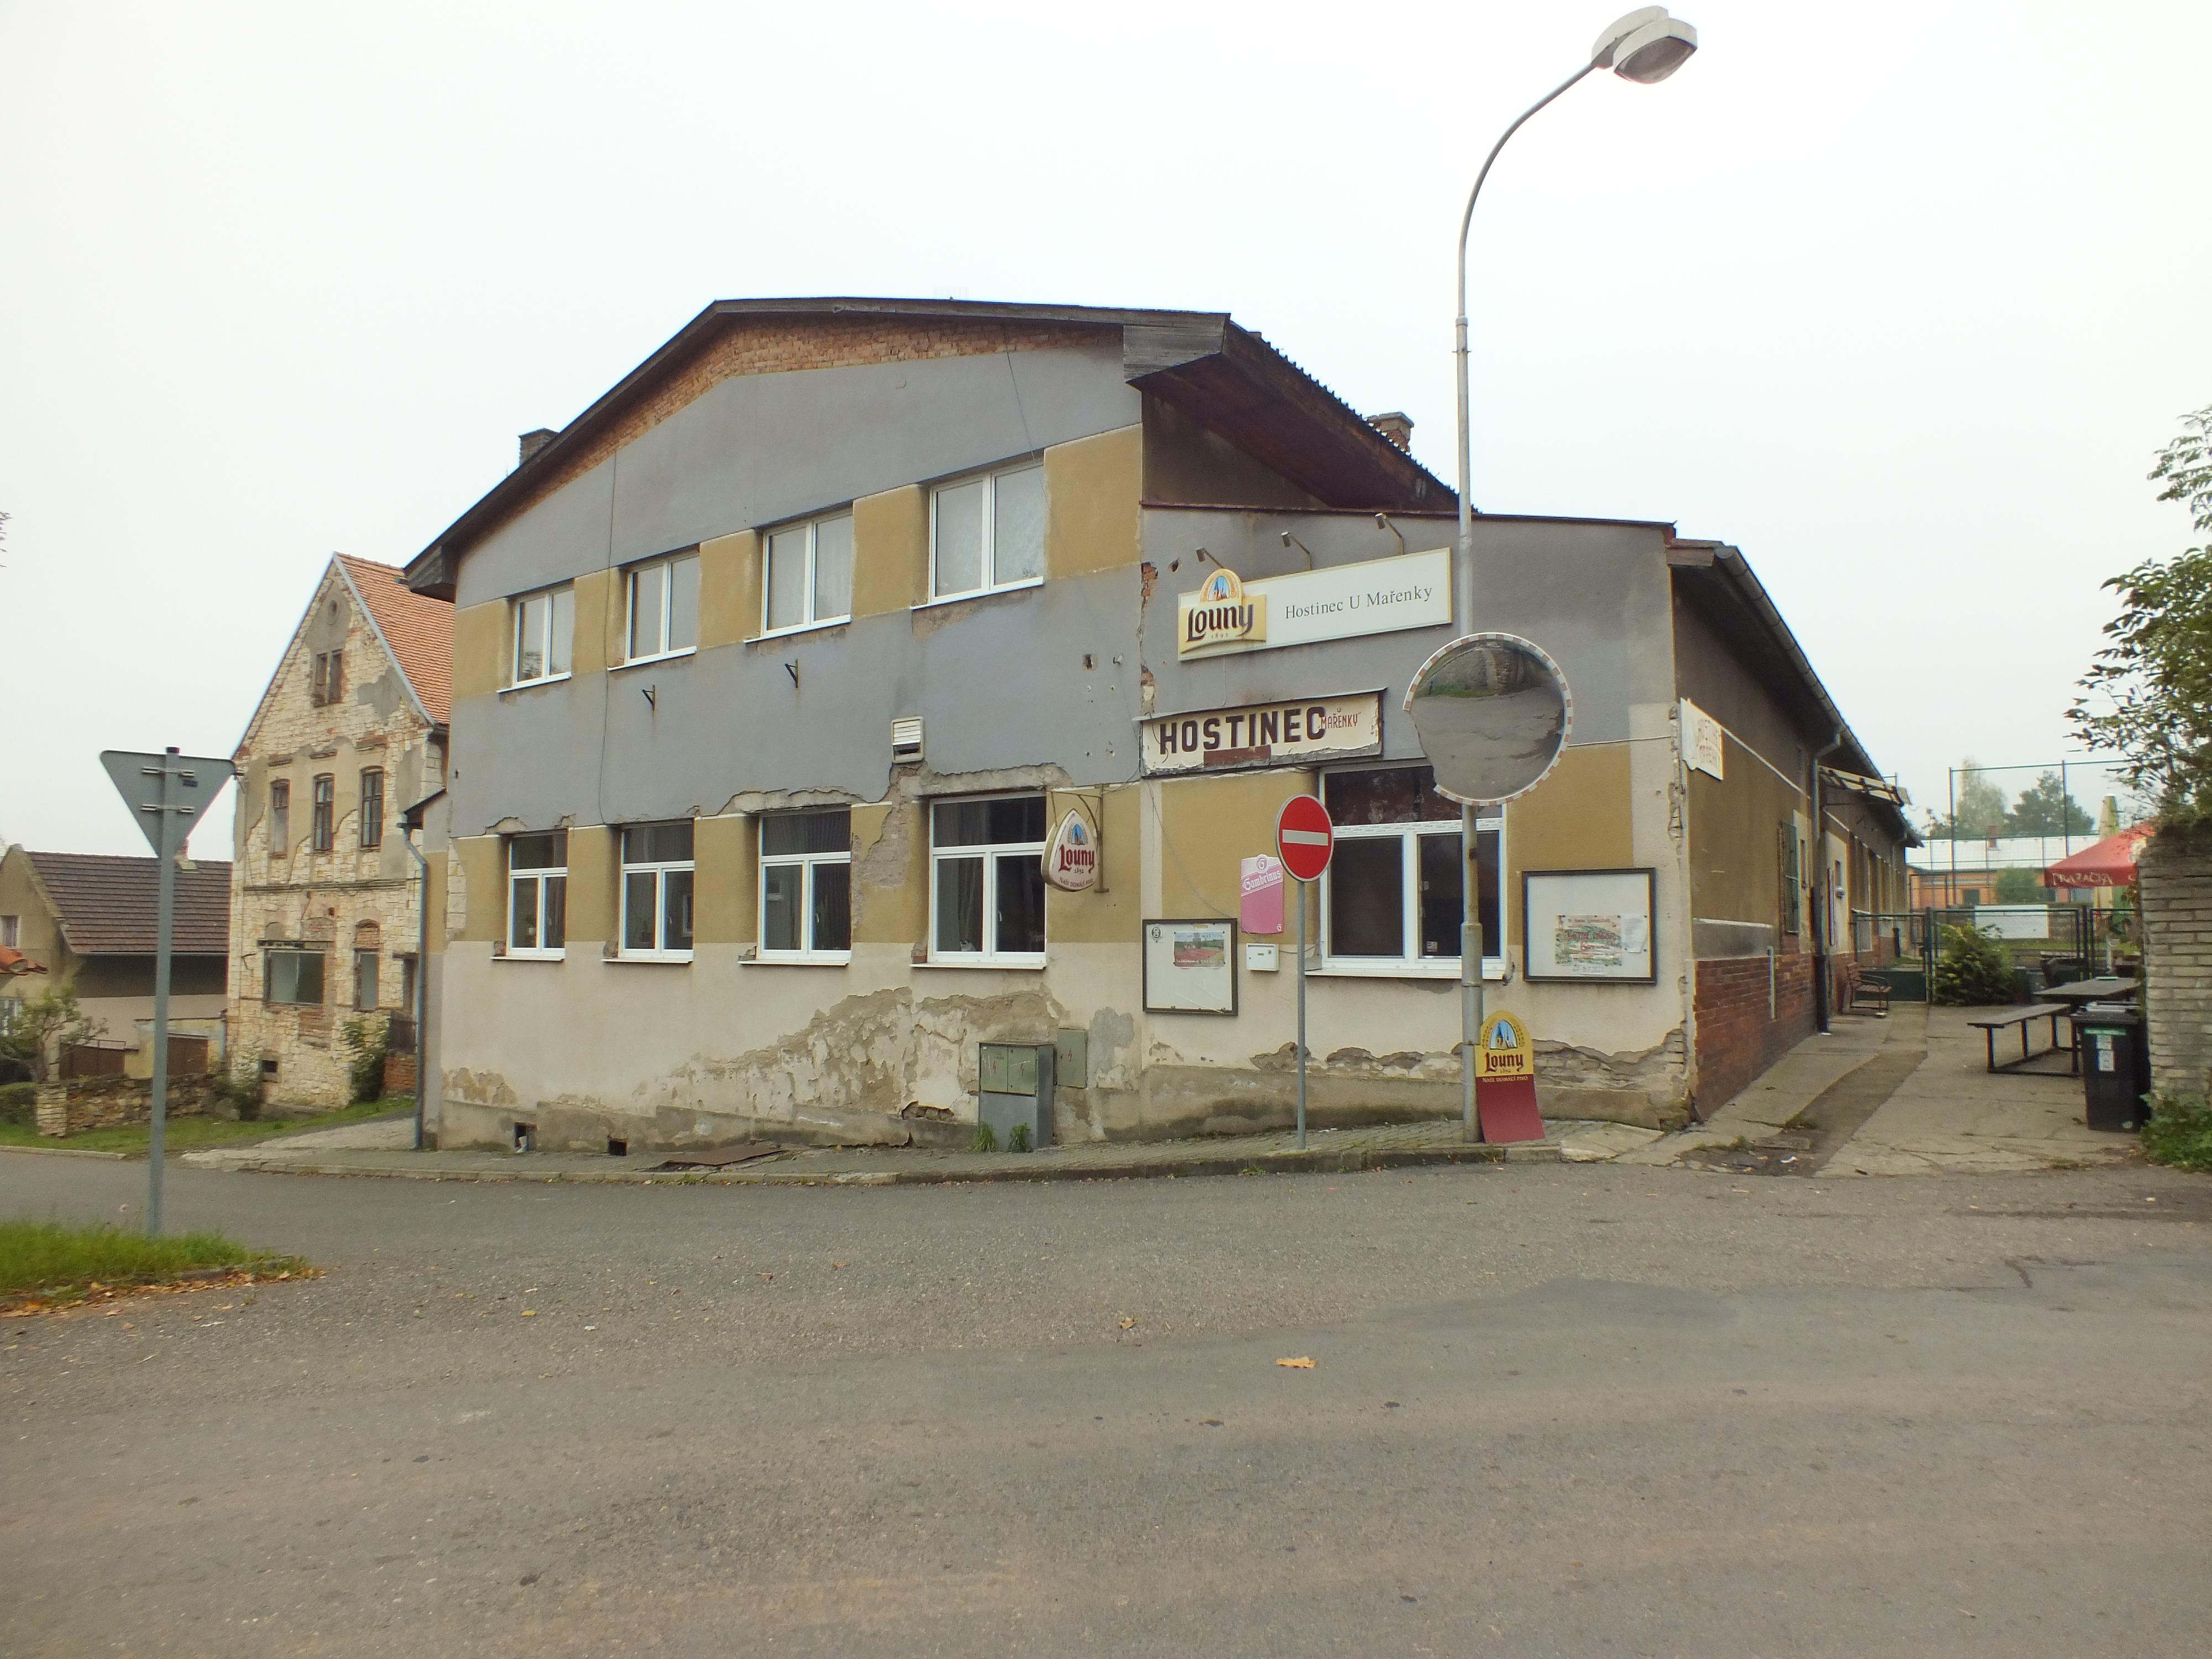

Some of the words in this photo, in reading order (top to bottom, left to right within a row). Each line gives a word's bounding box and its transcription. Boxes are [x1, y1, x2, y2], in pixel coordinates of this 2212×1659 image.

[1285, 601, 1344, 619] Hostinec
[1349, 595, 1360, 609] U
[1366, 586, 1433, 607] Mařenky
[1187, 604, 1254, 641] Louny
[1160, 706, 1326, 755] HOSTINEC
[1058, 844, 1095, 874] Louny
[1242, 870, 1281, 891] Gambrinus
[1485, 1052, 1524, 1073] Louny
